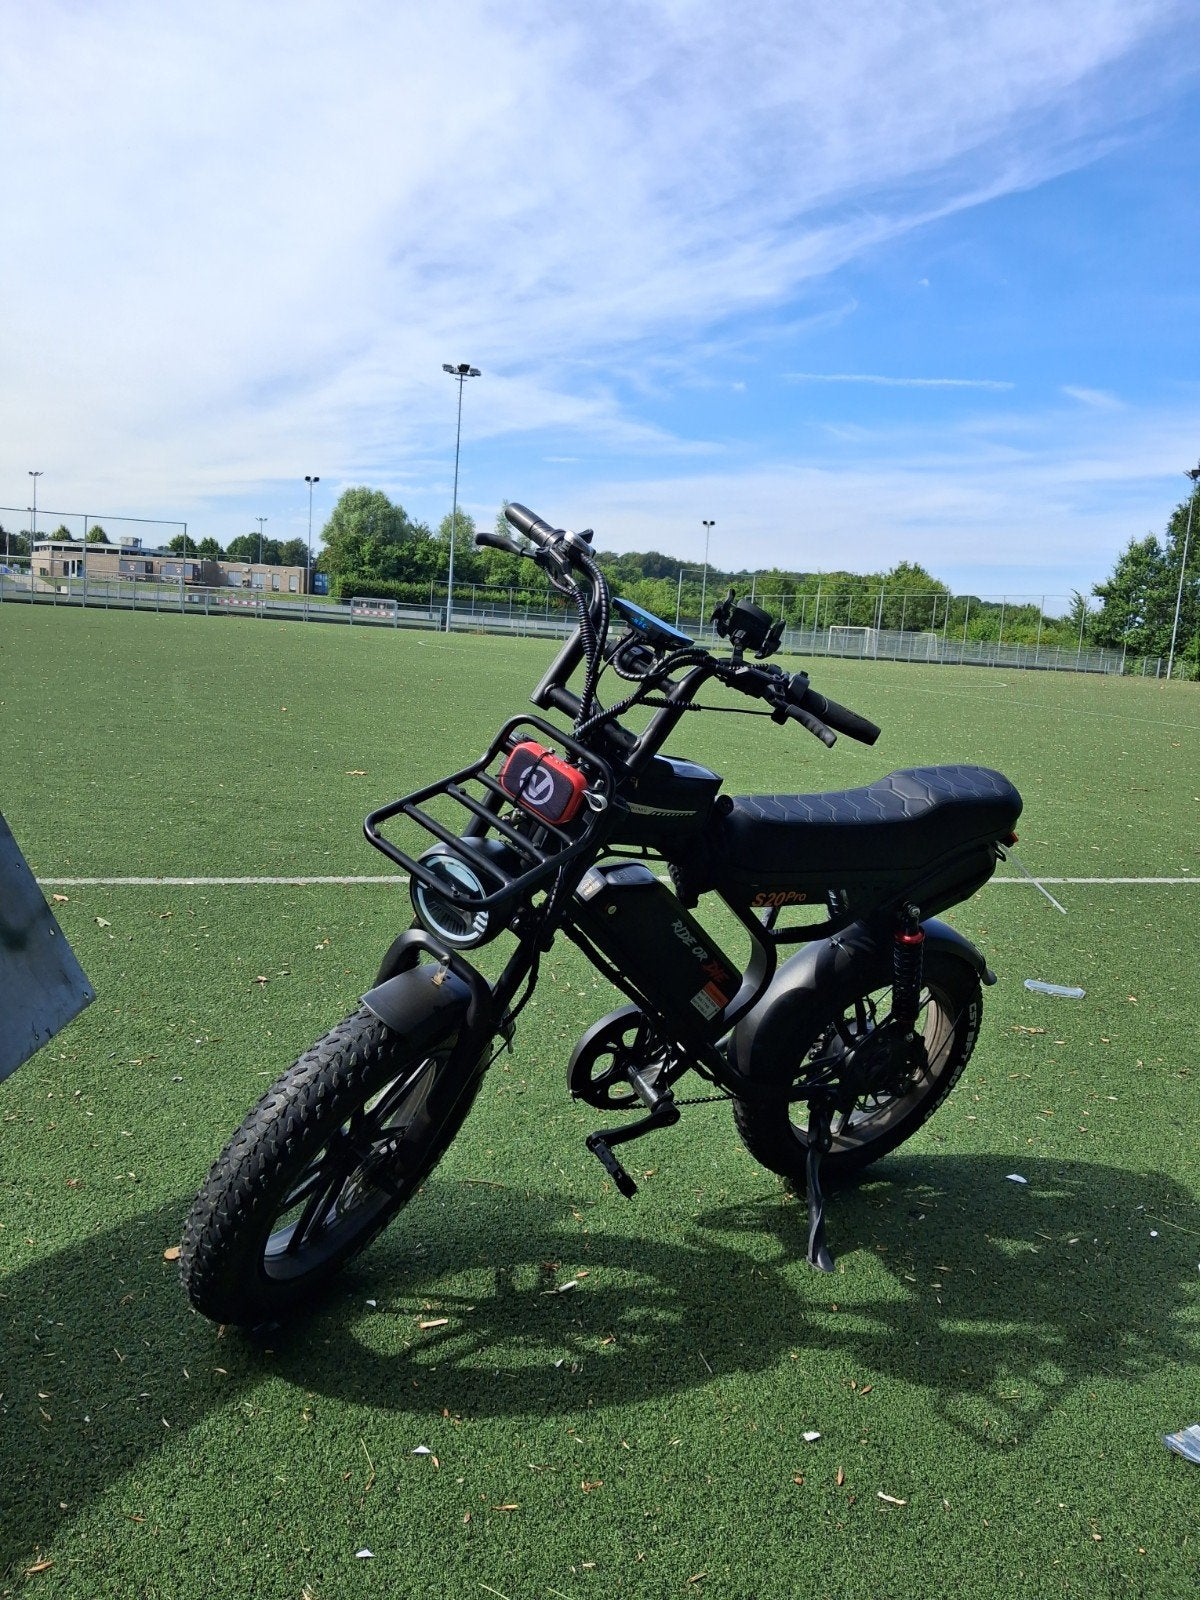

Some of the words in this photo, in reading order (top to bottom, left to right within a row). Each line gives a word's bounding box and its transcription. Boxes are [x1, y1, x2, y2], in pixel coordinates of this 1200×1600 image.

[672, 919, 697, 947] RIDE
[691, 946, 709, 962] OR
[968, 1003, 977, 1028] CST
